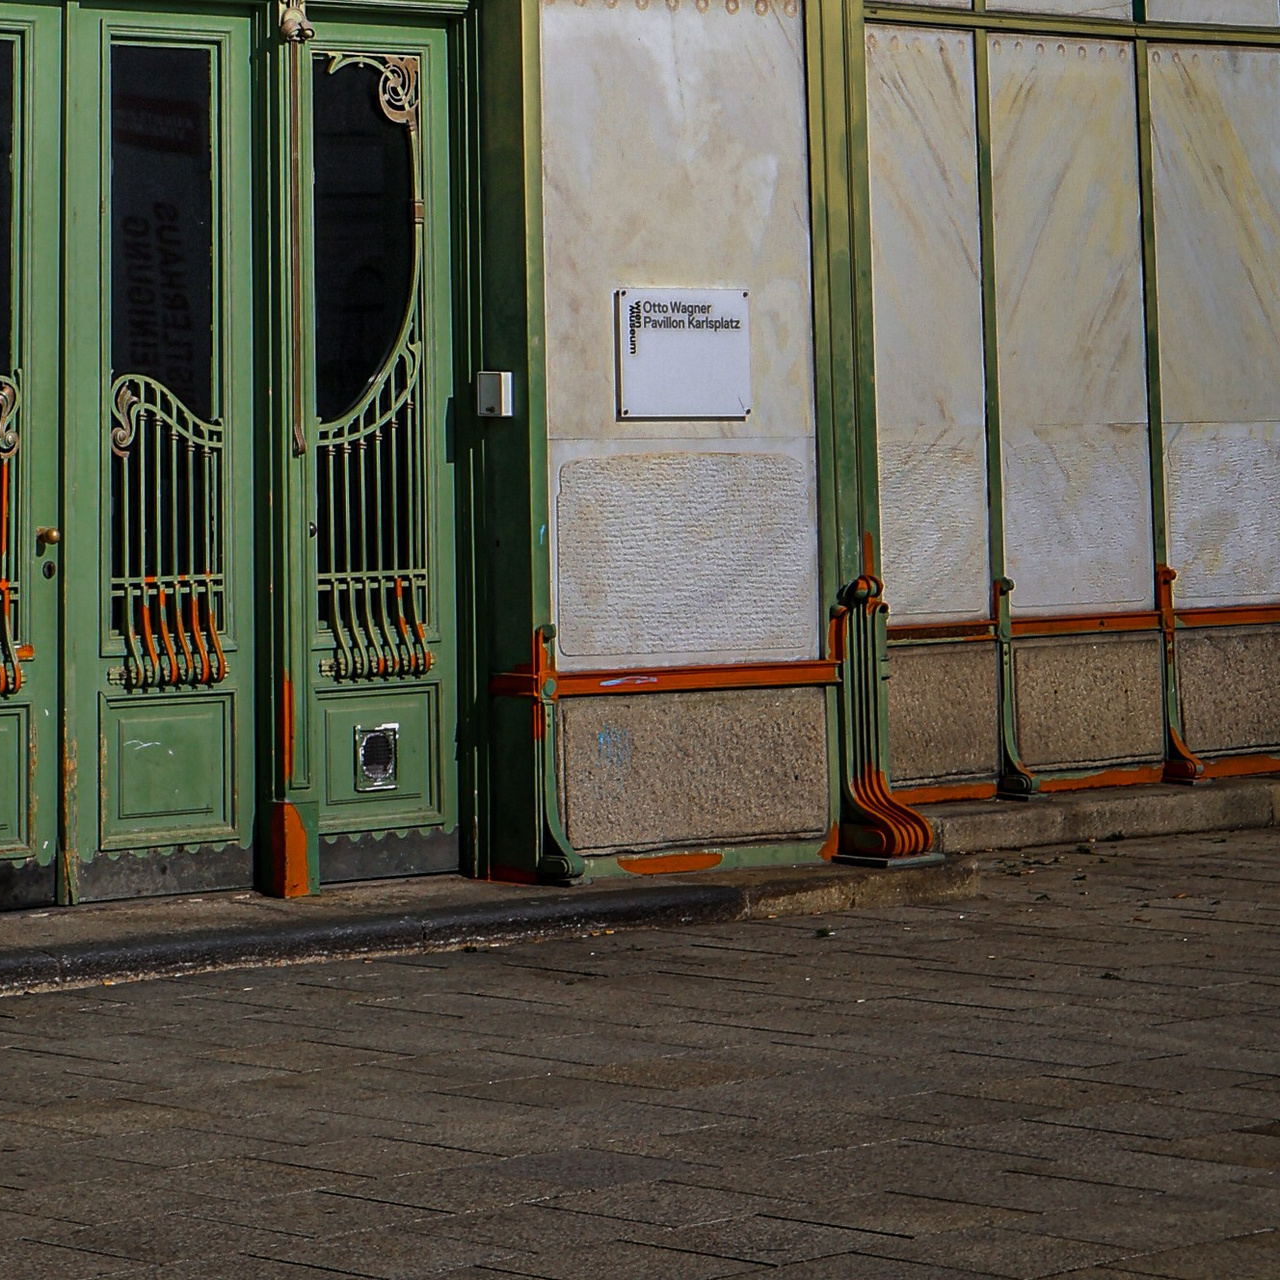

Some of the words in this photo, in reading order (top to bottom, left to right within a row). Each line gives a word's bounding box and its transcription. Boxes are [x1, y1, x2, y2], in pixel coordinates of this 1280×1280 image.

[643, 301, 668, 314] Otto
[669, 301, 711, 317] Wagner
[643, 316, 685, 329] Pavillon
[687, 317, 741, 332] Karlsplatz
